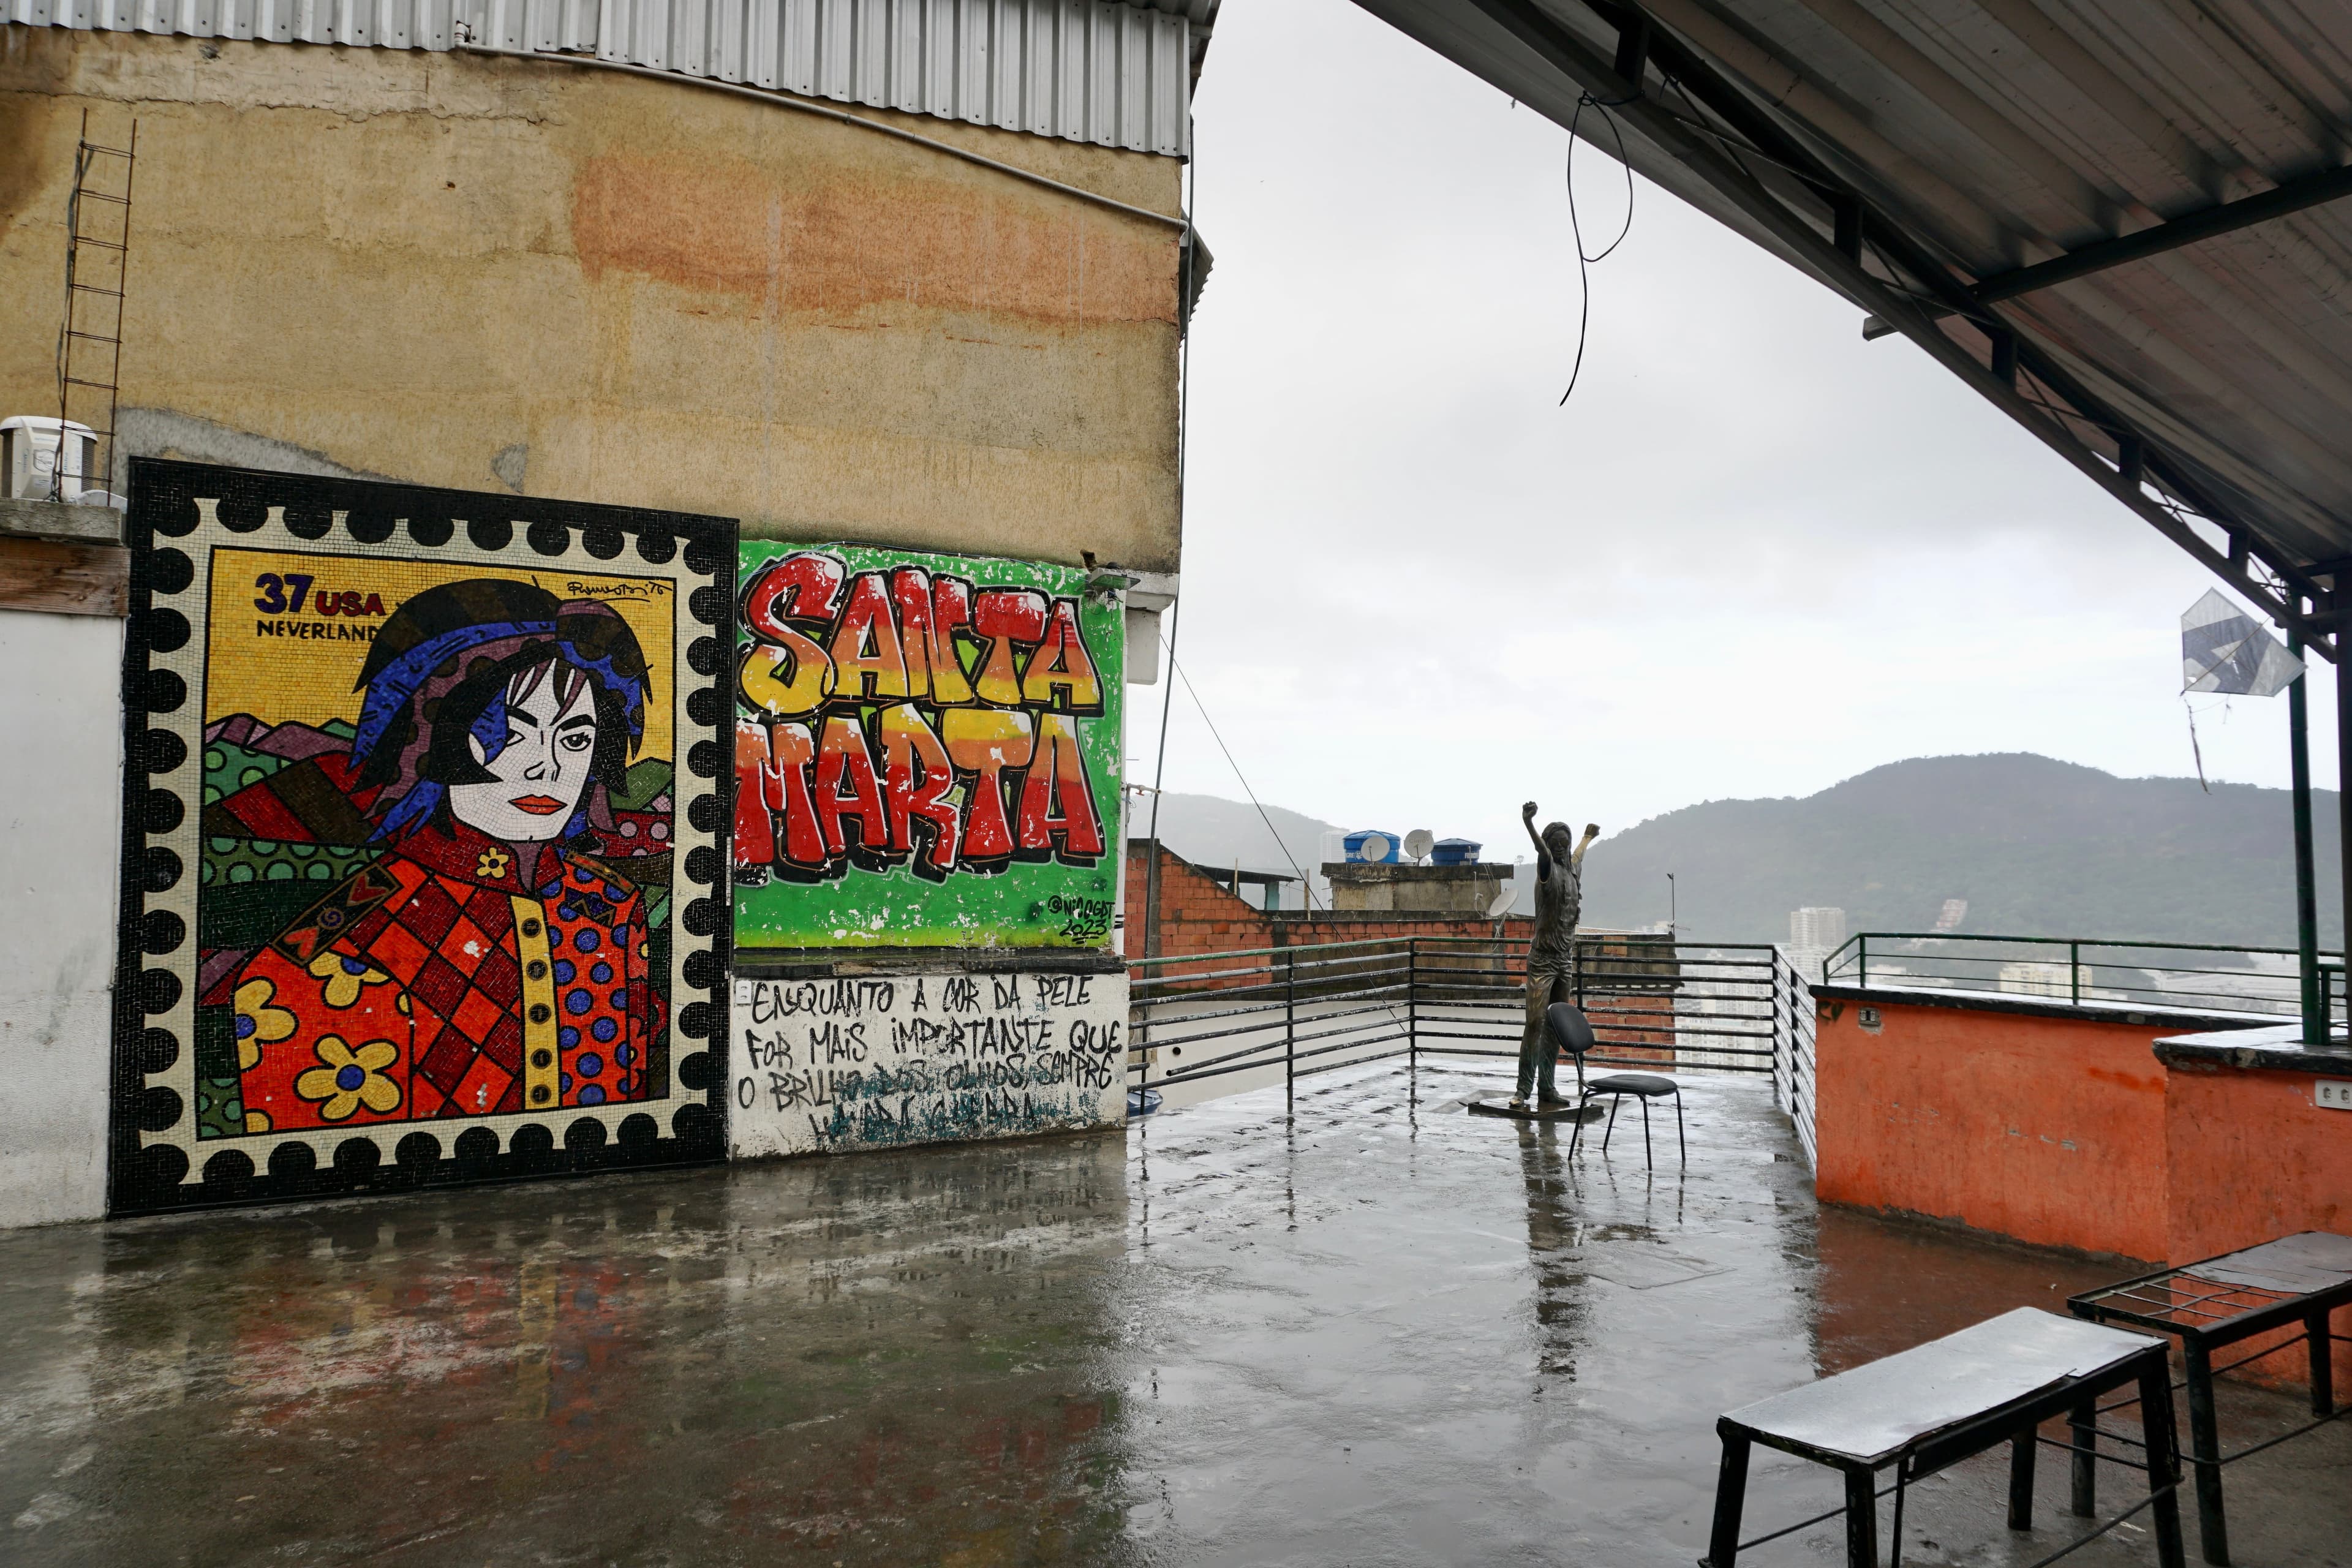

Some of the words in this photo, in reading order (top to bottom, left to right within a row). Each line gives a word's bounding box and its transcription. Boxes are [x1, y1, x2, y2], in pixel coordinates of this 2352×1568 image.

[254, 572, 314, 614] 37
[315, 590, 387, 617] USA
[256, 620, 380, 643] NEVERLAND
[737, 551, 1106, 722] SANTA
[734, 703, 1107, 883] MARTA
[1059, 919, 1107, 937] 2023
[752, 979, 894, 1024] ENQUANTO
[911, 978, 928, 1012] A
[943, 976, 981, 1014] COR
[990, 974, 1021, 1011] DA
[1033, 975, 1094, 1008] PELE
[745, 1029, 793, 1070] FOR
[1069, 1019, 1122, 1055] QUE
[738, 1076, 755, 1109] O
[1036, 1049, 1114, 1090] SEMPRE
